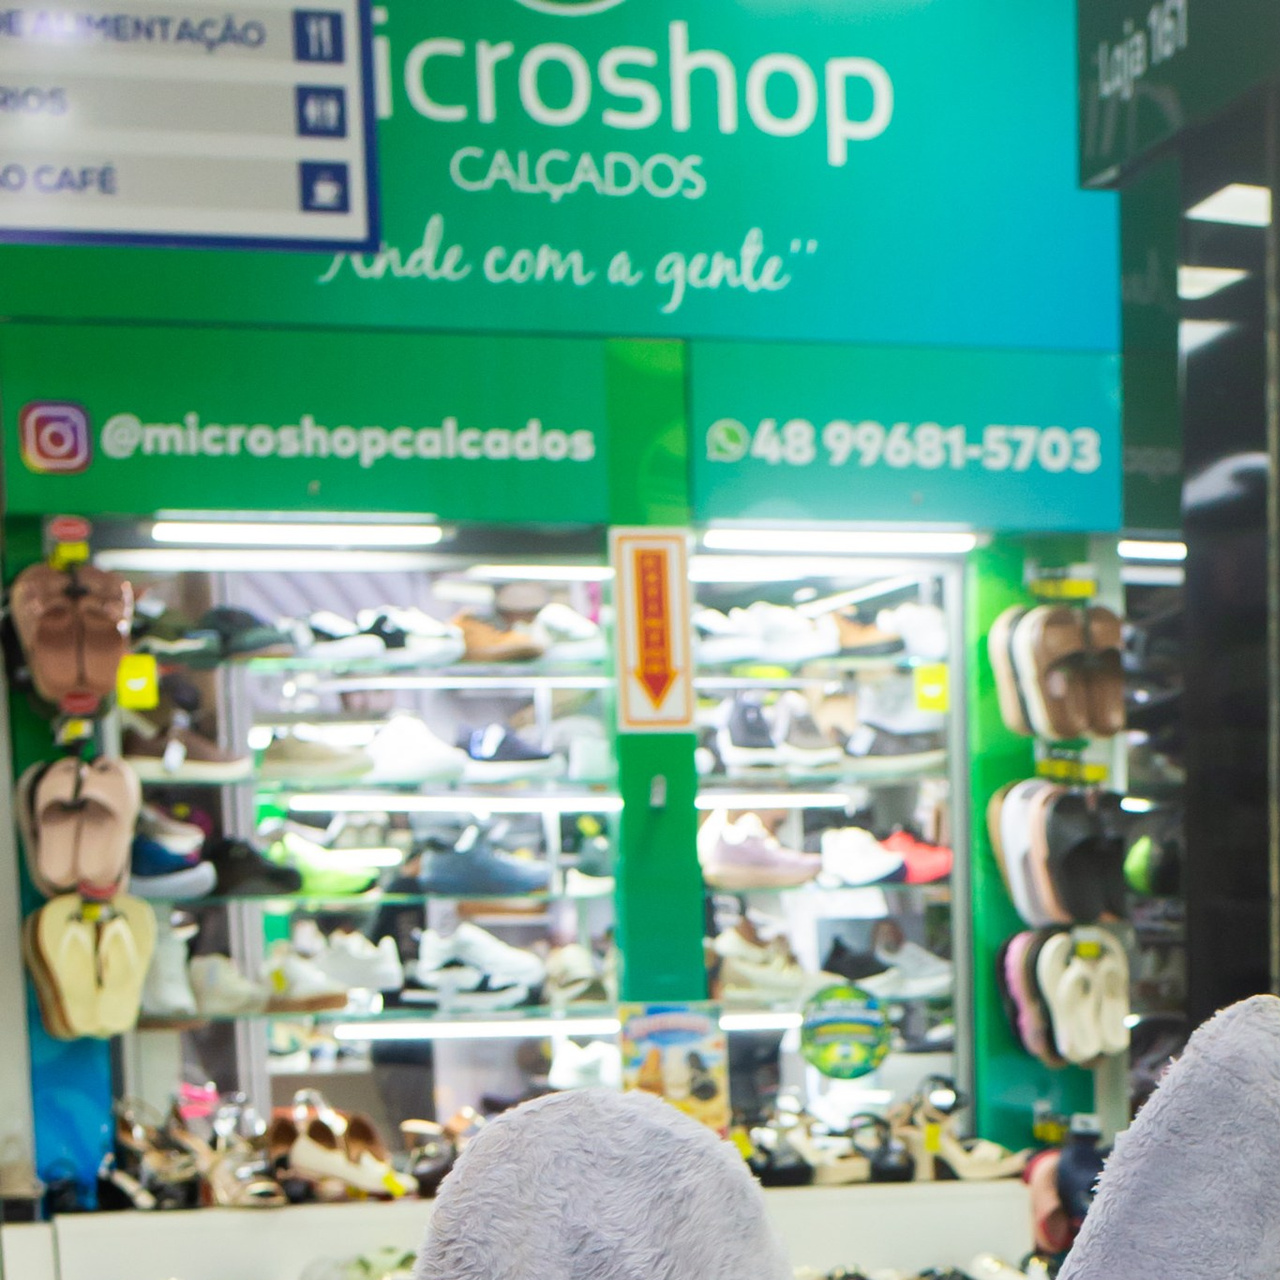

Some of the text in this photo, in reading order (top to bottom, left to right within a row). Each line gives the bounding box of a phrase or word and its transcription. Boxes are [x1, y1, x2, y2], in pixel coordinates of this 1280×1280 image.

[1097, 17, 1147, 100] Loja
[33, 161, 118, 196] CAFÉ
[449, 146, 708, 203] CALÇADOS
[483, 244, 596, 286] com
[607, 250, 643, 287] a
[101, 411, 596, 468] @microshopcalcados
[750, 418, 1101, 474] 48 99681-5703
